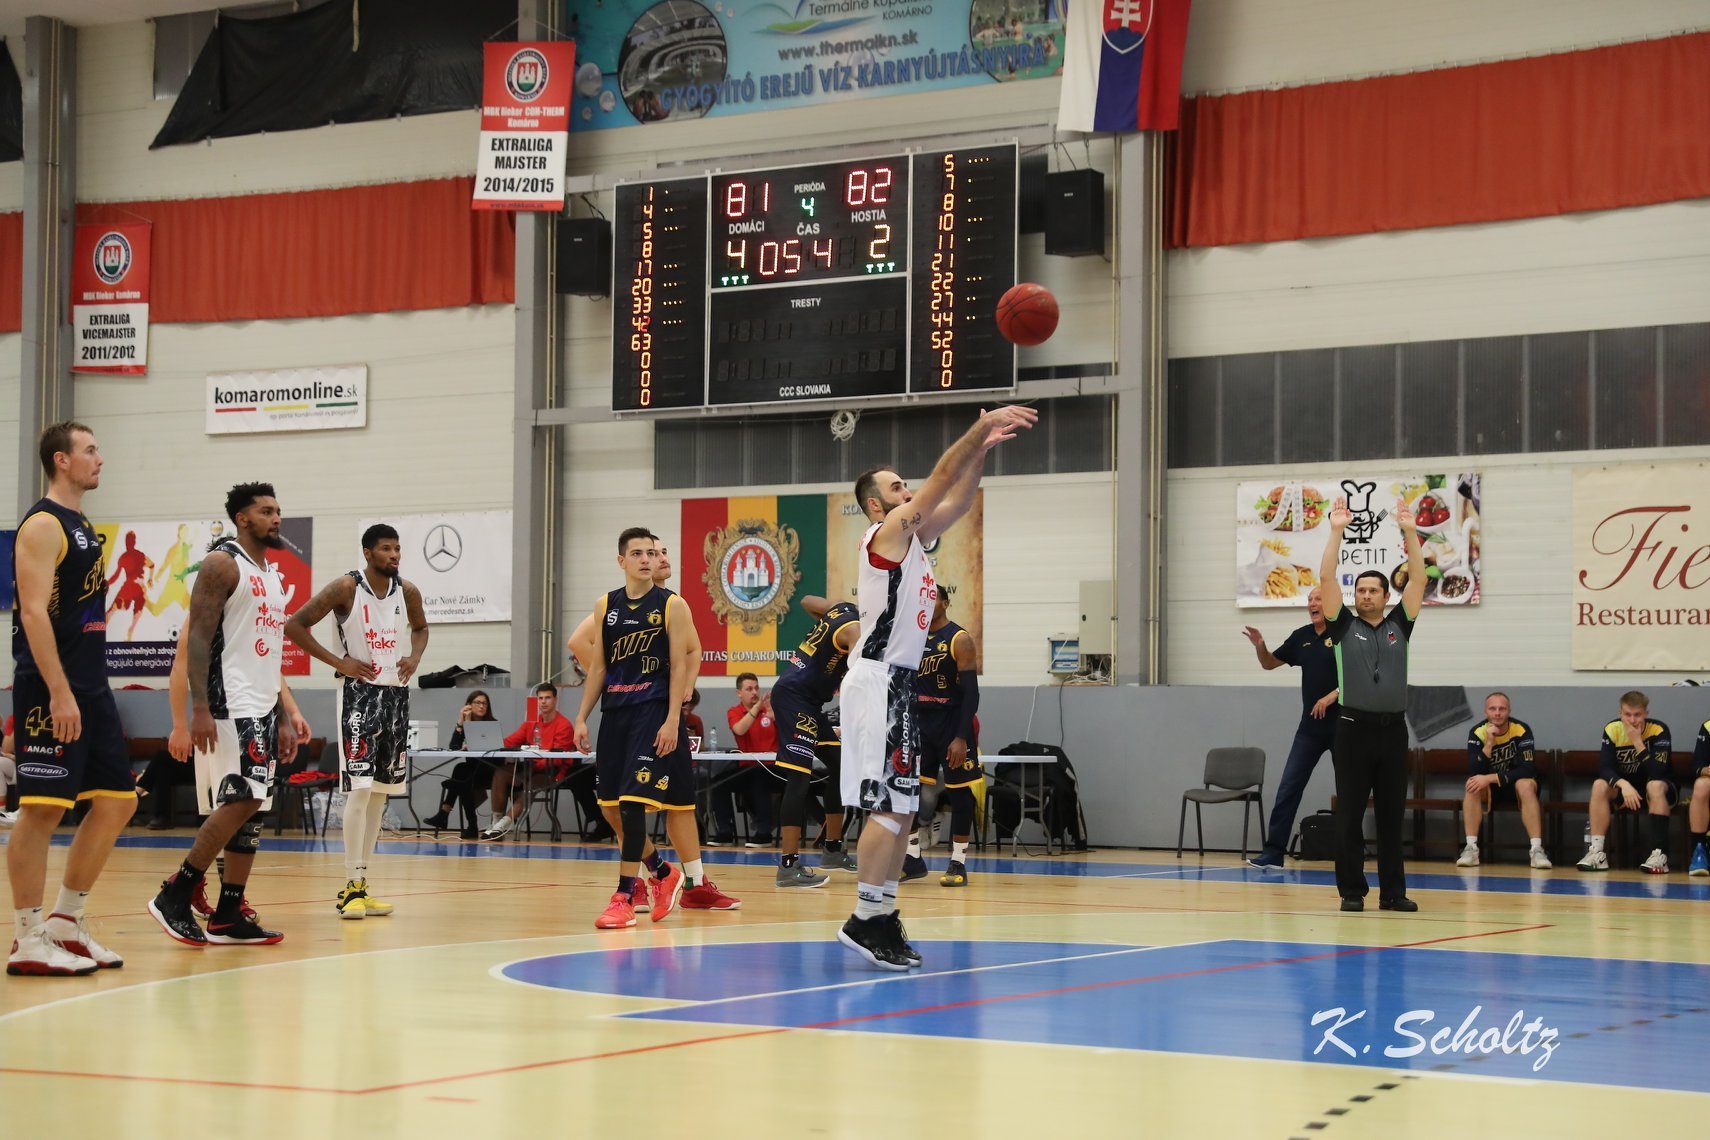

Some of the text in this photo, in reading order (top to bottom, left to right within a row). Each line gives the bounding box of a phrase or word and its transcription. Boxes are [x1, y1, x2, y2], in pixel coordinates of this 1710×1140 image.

[882, 5, 933, 20] KOMÁRNO
[778, 29, 919, 61] www.thermalkn.sk
[661, 42, 1047, 112] GYÓGYÍTÓ EREJŰ VÍZ KARNYÚJTÁSNYIRA
[491, 138, 553, 152] EXTRALIGA
[494, 156, 547, 170] MAJSTER
[944, 153, 955, 172] 5
[483, 177, 554, 193] 2014/2015
[794, 182, 826, 194] PERIÓDA
[848, 168, 892, 205] 82
[946, 173, 955, 190] 7
[648, 186, 654, 201] 1
[727, 182, 769, 217] 81
[943, 193, 954, 211] 8
[643, 205, 653, 219] 4
[801, 196, 815, 217] 4
[851, 210, 887, 223] HOSTIA
[938, 212, 954, 231] 10
[642, 222, 653, 239] 5
[728, 220, 765, 235] DOMÁCI
[796, 221, 820, 235] ČAS
[642, 241, 653, 258] 8
[870, 224, 891, 259] 2
[938, 233, 954, 250] 11
[727, 239, 746, 268] 4
[931, 252, 954, 271] 21
[637, 259, 652, 276] 17
[632, 277, 652, 296] 20
[931, 271, 954, 291] 22
[632, 296, 652, 314] 33
[790, 297, 822, 309] TRESTY
[931, 291, 954, 310] 27
[89, 314, 131, 326] EXTRALIGA
[632, 315, 651, 333] 42
[931, 312, 953, 328] 44
[82, 328, 136, 340] VICEMAJSTER
[631, 332, 651, 351] 63
[931, 330, 953, 350] 52
[82, 345, 135, 360] 2011/2012
[640, 352, 651, 369] 0
[941, 350, 953, 368] 0
[640, 370, 651, 387] 0
[941, 369, 953, 388] 0
[215, 381, 358, 404] komaromonline.sk
[640, 388, 650, 406] 0
[779, 383, 832, 397] CCC SLOVAKIA
[1337, 548, 1388, 565] PETIT
[249, 575, 267, 597] 33
[440, 594, 457, 605] Nové
[459, 594, 485, 606] Zámky
[363, 604, 370, 624] 1
[641, 655, 660, 674] 10
[936, 674, 948, 689] 5
